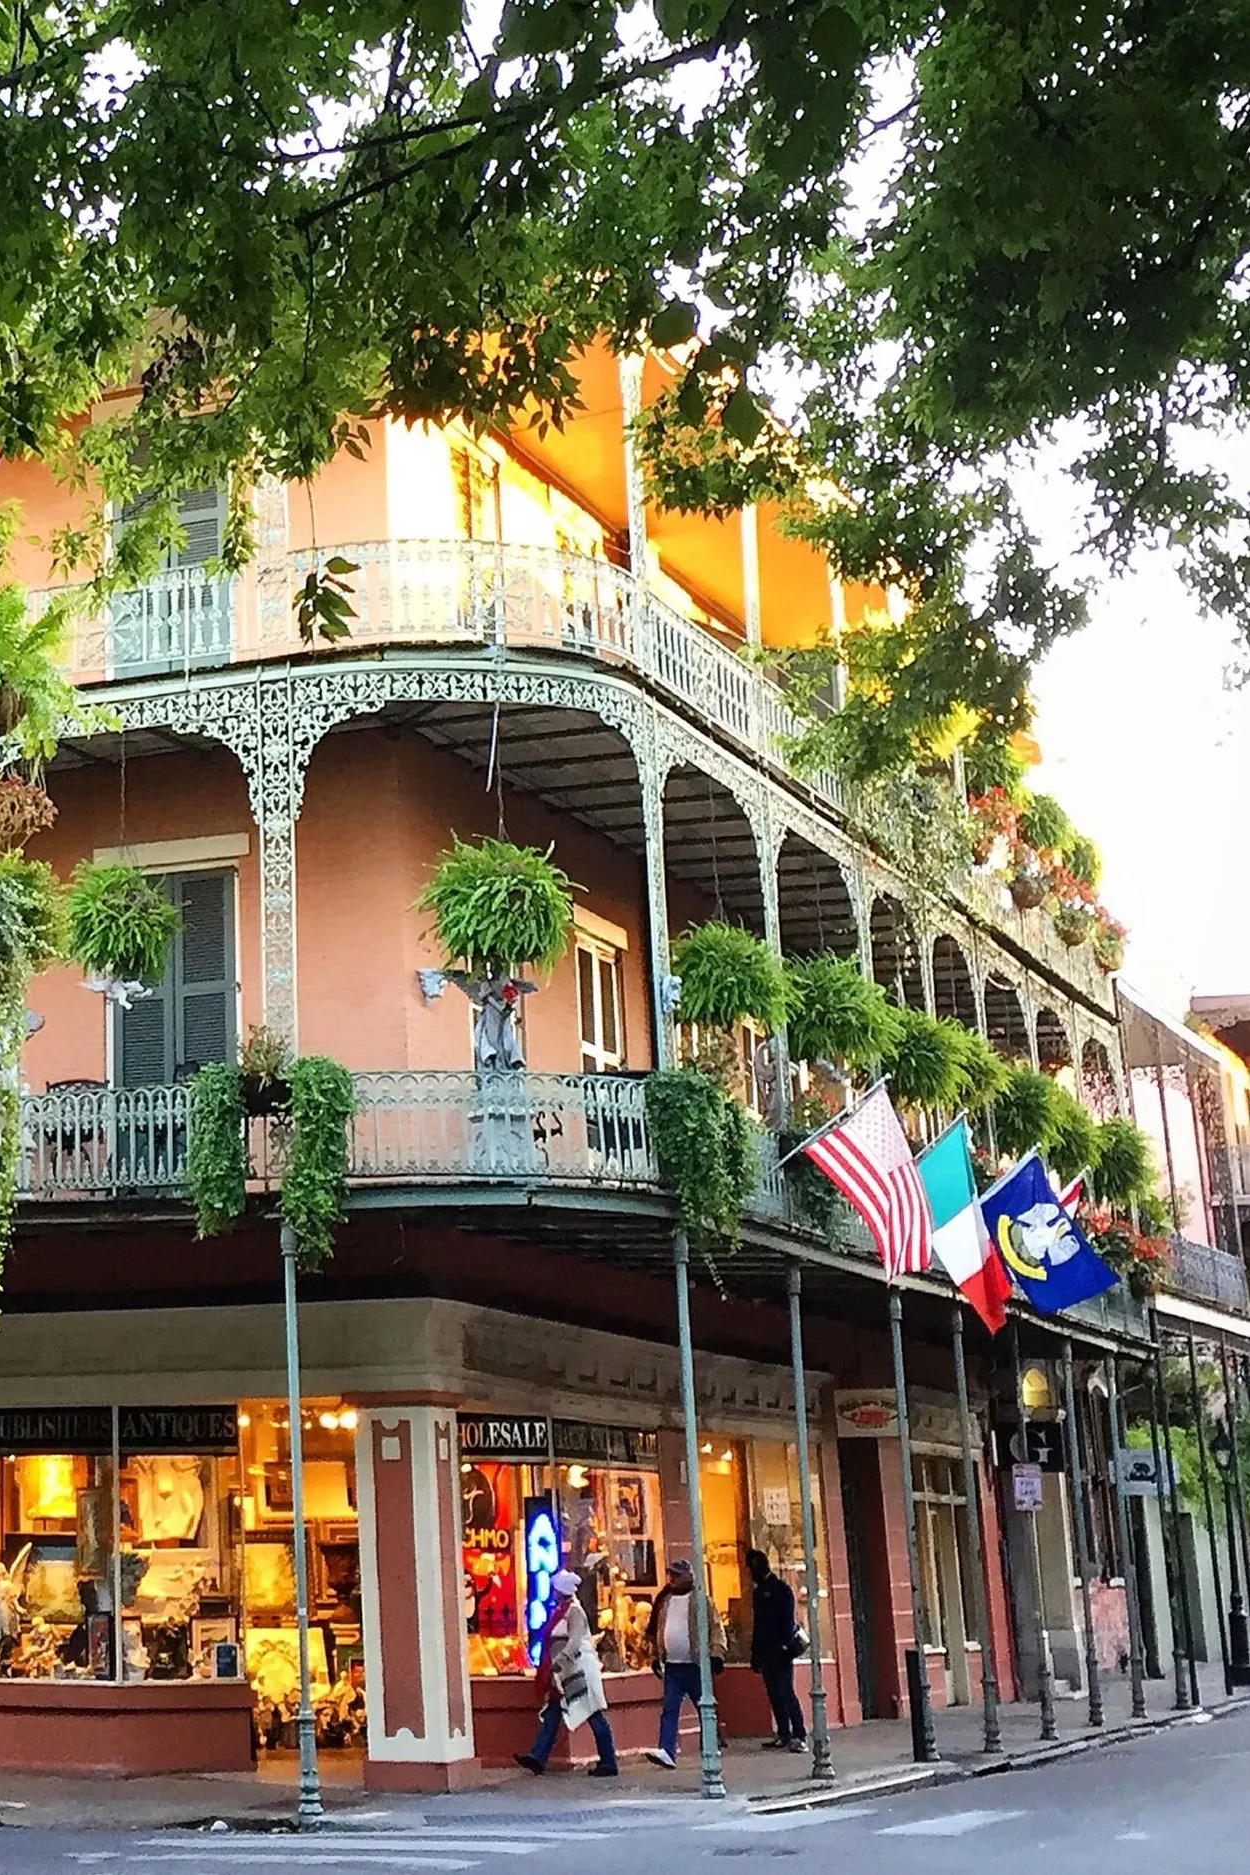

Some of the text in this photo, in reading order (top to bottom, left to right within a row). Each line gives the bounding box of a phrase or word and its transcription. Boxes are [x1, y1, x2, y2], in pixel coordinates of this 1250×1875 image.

[122, 1411, 236, 1442] ANTIQUES
[456, 1421, 547, 1449] HOLESALE
[462, 1528, 510, 1549] CHMO
